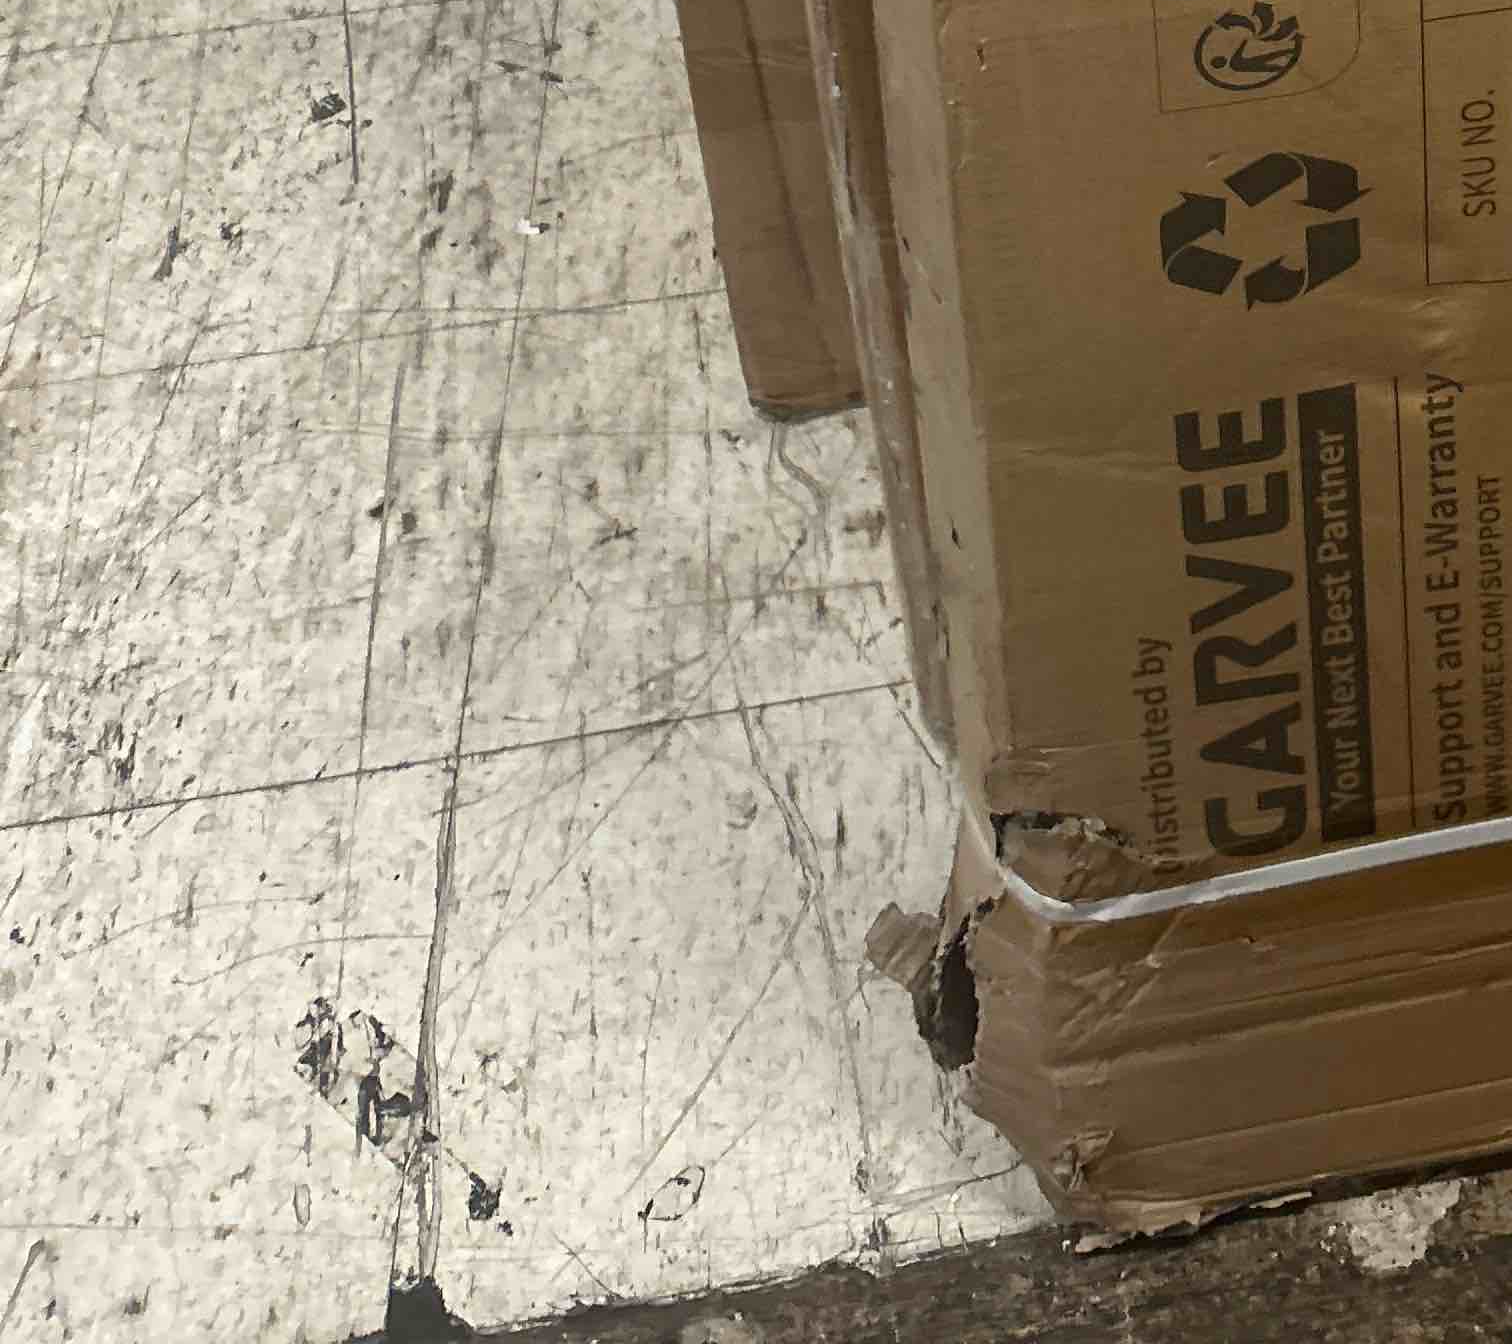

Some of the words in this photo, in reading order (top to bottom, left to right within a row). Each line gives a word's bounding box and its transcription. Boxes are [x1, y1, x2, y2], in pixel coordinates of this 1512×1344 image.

[1461, 89, 1497, 151] NO.
[1463, 155, 1496, 218] SKU
[1313, 429, 1350, 563] Partner
[1421, 372, 1465, 592] E-Warranty
[1174, 397, 1307, 856] GARVEE
[1318, 571, 1354, 646] Best
[1424, 602, 1463, 670] and
[1131, 637, 1173, 678] by
[1323, 654, 1360, 728] Next
[1330, 737, 1363, 810] Your
[1431, 679, 1474, 821] Support
